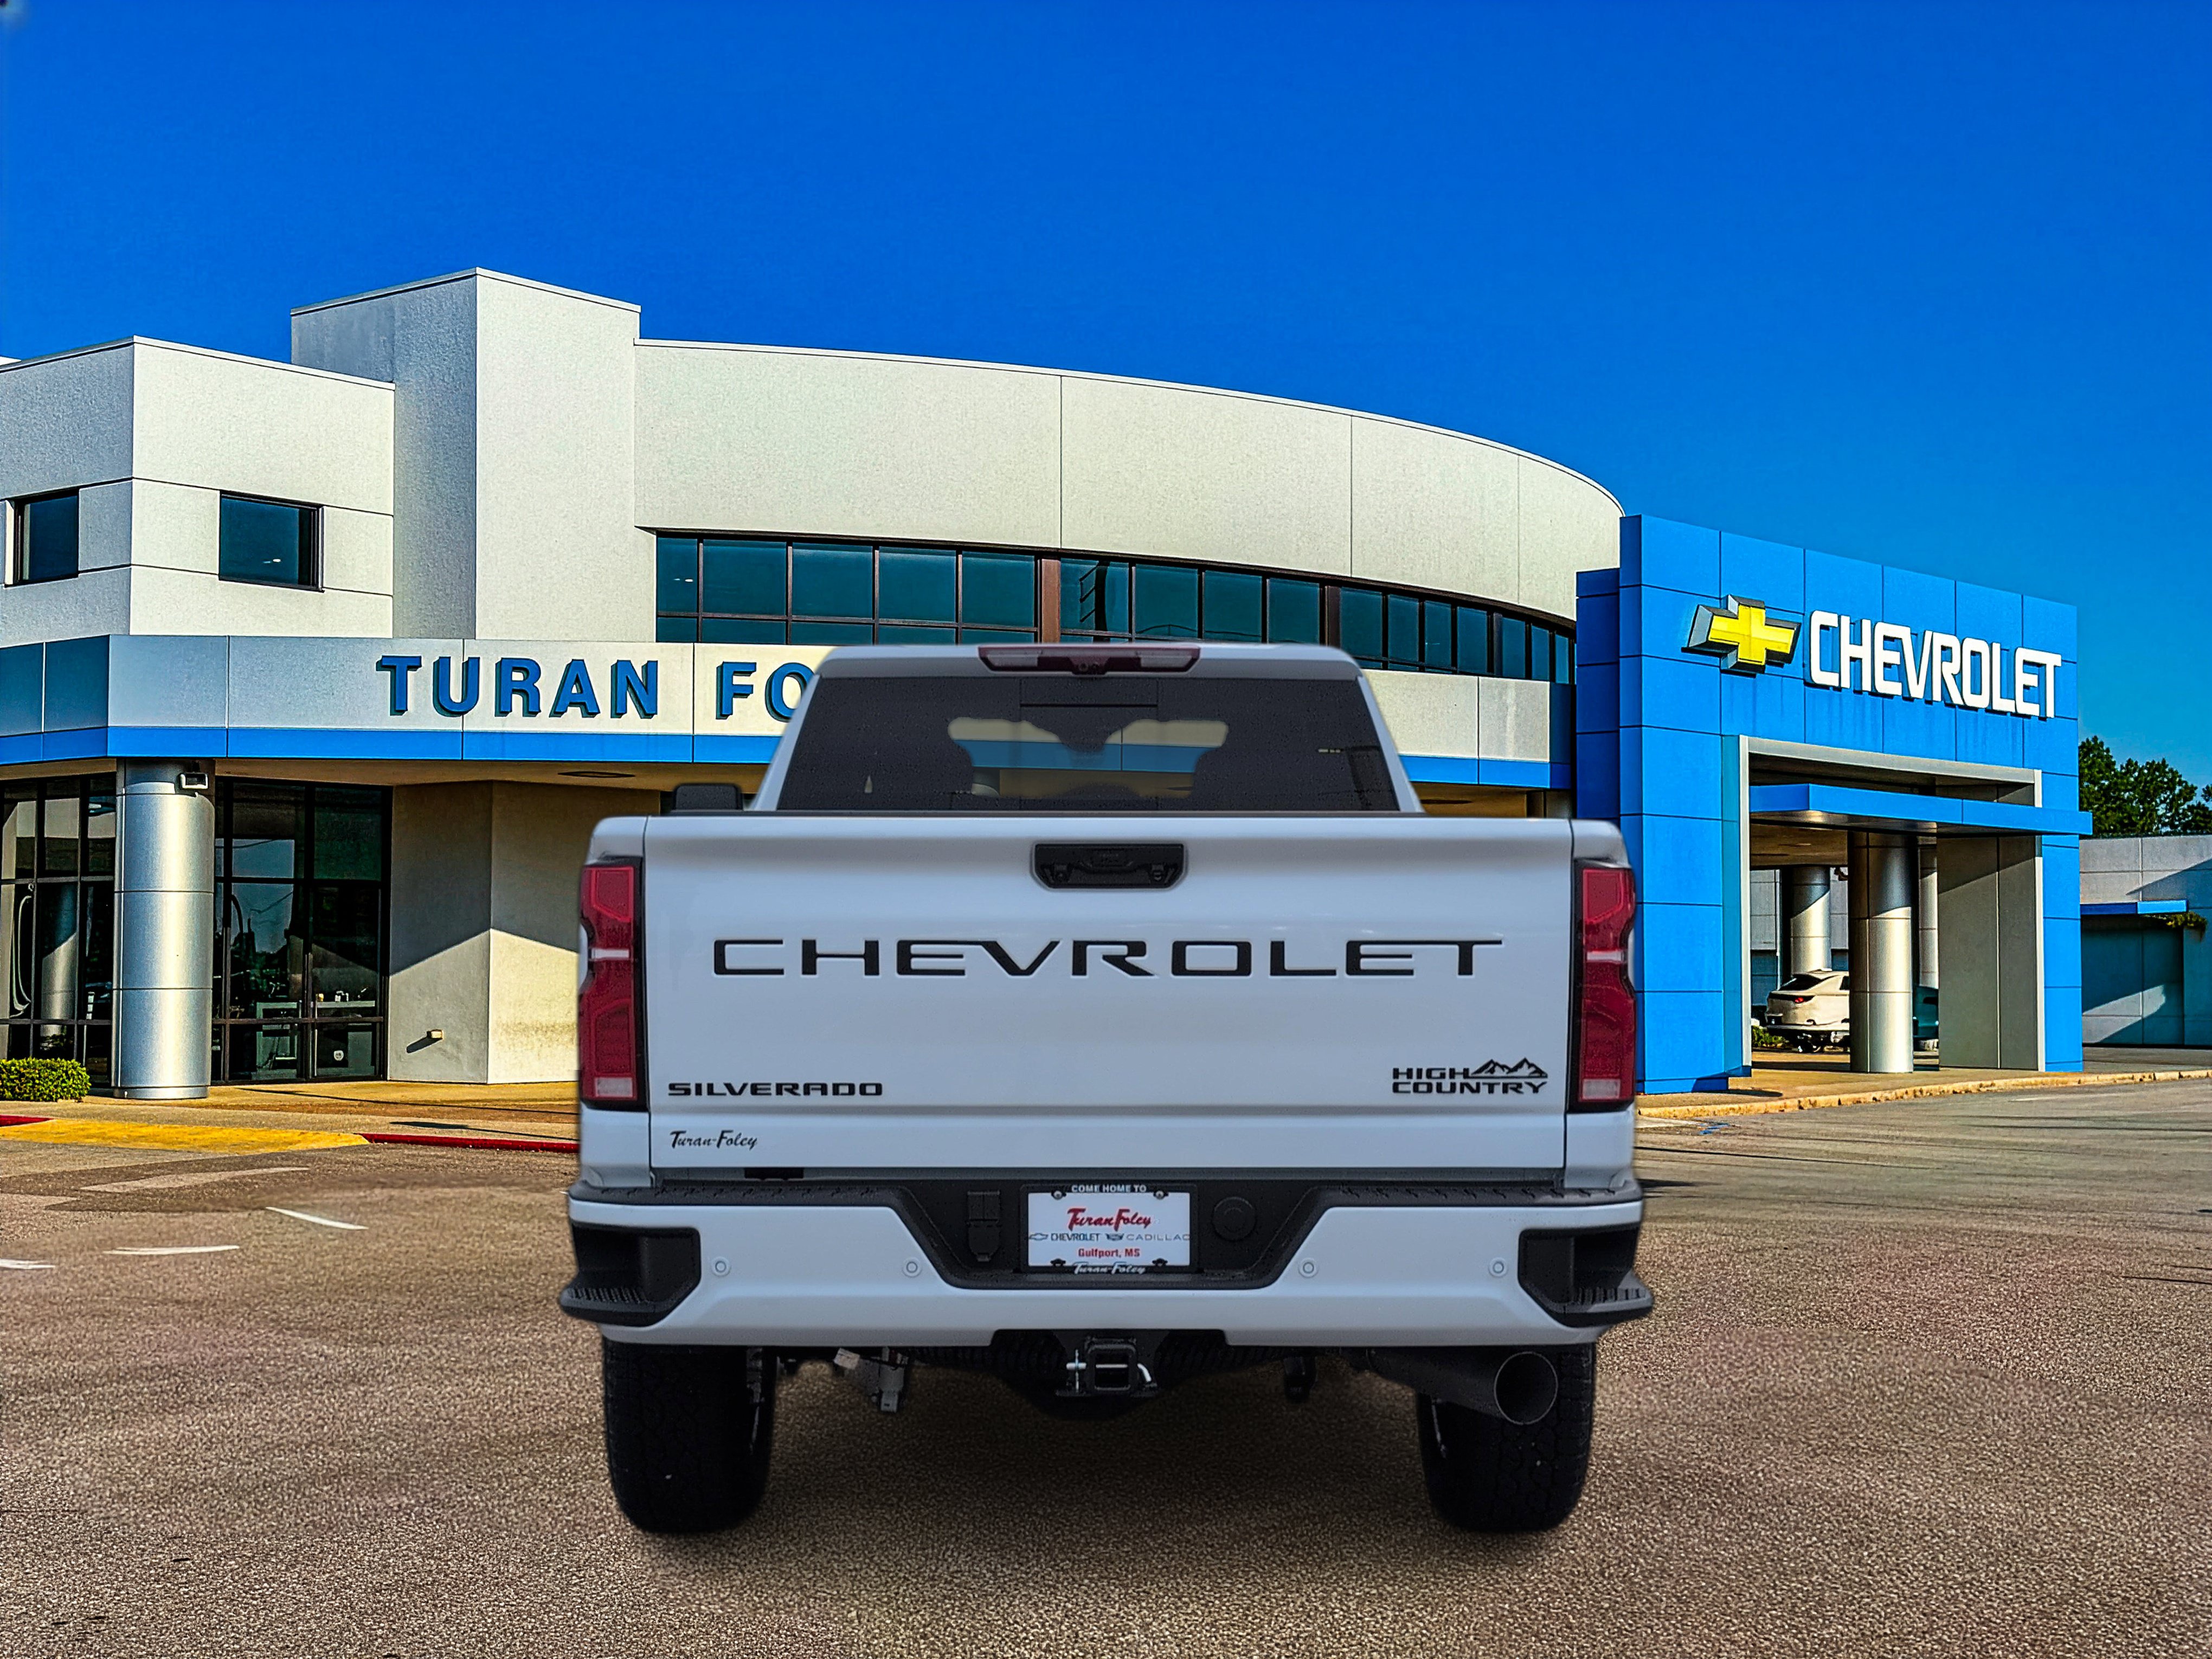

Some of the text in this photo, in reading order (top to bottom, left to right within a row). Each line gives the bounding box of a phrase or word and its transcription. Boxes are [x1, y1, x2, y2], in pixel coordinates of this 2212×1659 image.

[1806, 610, 2062, 718] CHEVROLET
[376, 655, 658, 719] TURAN
[713, 940, 1503, 977] CHEVROLET
[1392, 1068, 1470, 1079] HIGH
[668, 1083, 883, 1096] SILVERADO
[1392, 1082, 1548, 1094] COUNTRY
[1071, 1185, 1099, 1193] COME
[1102, 1185, 1131, 1193] HOME
[1051, 1233, 1101, 1242] CHEVROLET
[1078, 1248, 1140, 1258] Gulfport, MS
